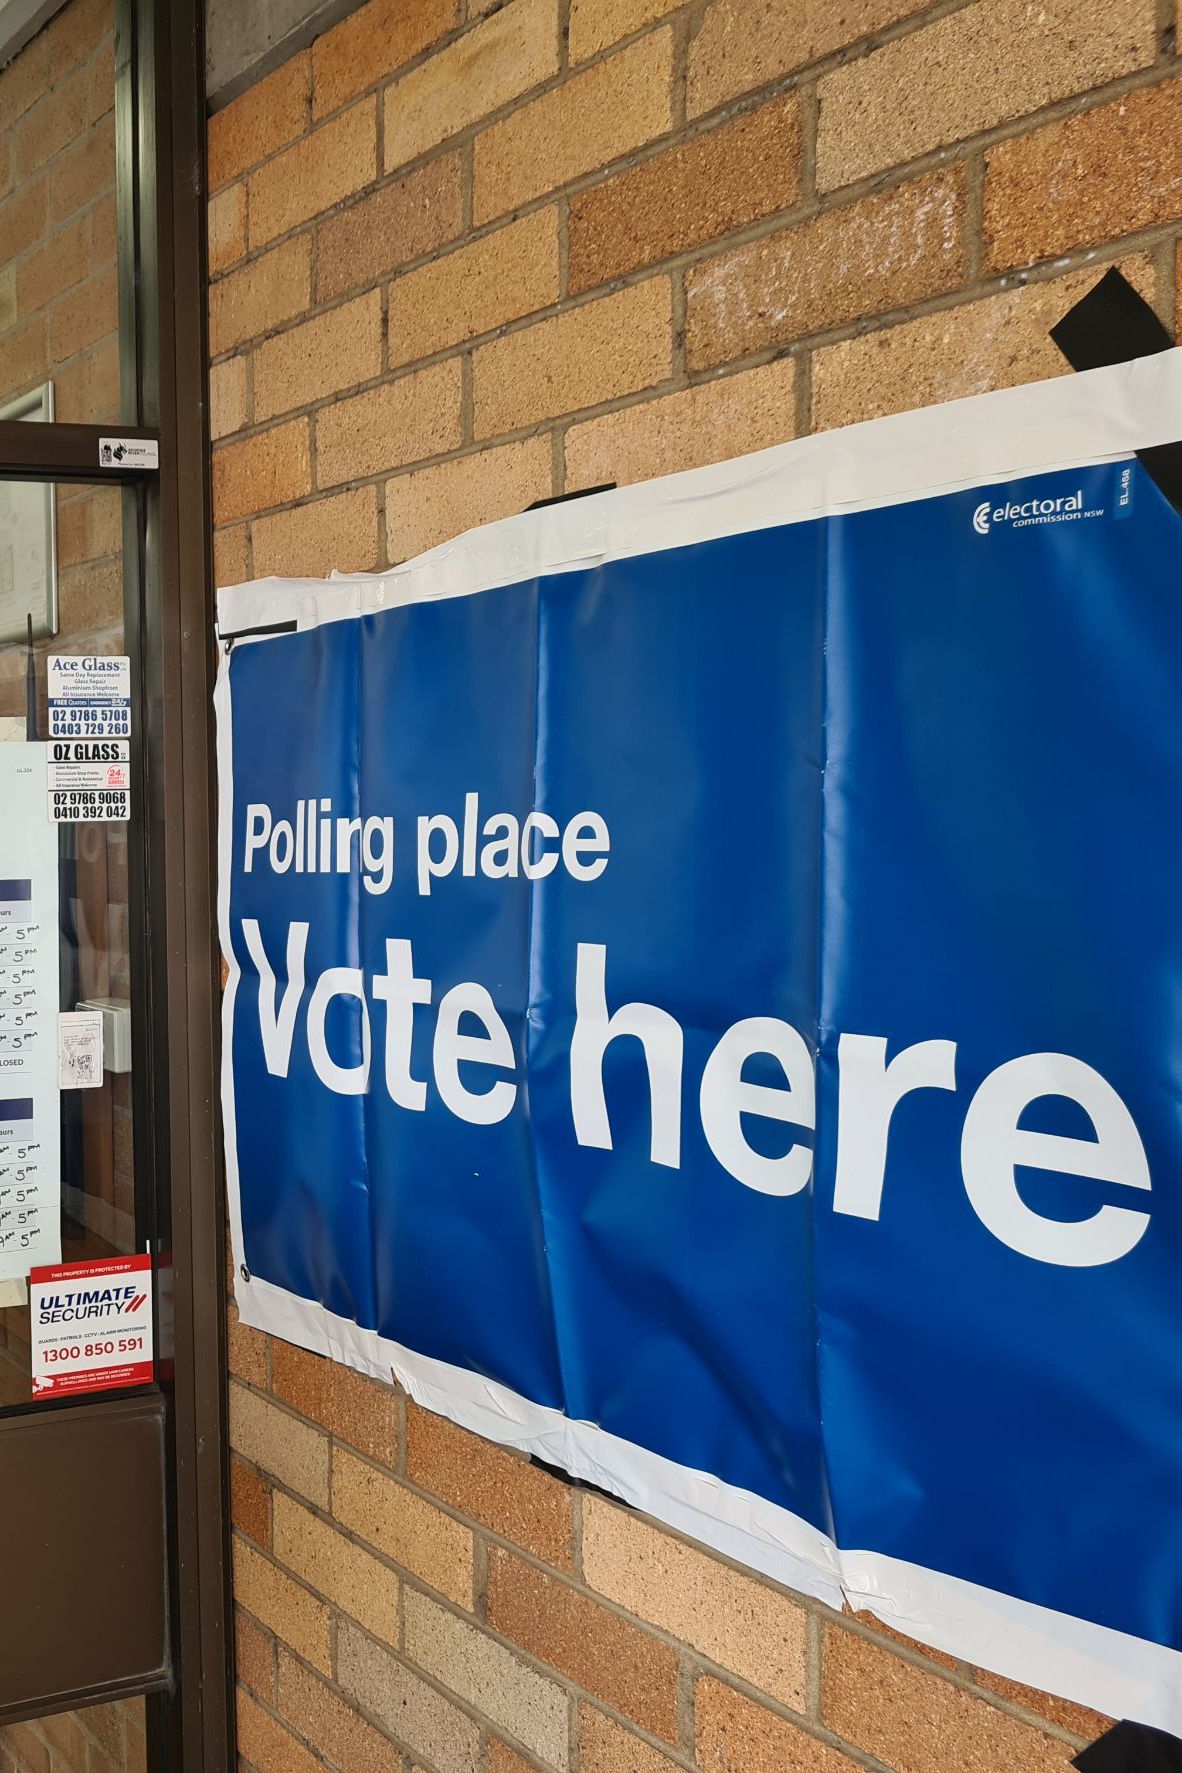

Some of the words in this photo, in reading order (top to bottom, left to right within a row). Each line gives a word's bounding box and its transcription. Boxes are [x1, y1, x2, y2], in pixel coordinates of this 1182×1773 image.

[1119, 469, 1130, 507] EL.458
[992, 490, 1082, 522] electoral
[1012, 512, 1081, 528] commission
[1083, 509, 1104, 518] NSW
[52, 657, 78, 671] Ace
[82, 657, 120, 671] Glass
[53, 709, 66, 721] 02
[70, 709, 98, 721] 9786
[101, 709, 128, 721] 5708
[53, 723, 81, 735] 0403
[85, 723, 104, 735] 729
[107, 723, 128, 735] 260
[54, 743, 71, 760] OZ
[74, 743, 119, 760] GLASS
[54, 793, 67, 805] 02
[70, 792, 96, 805] 9786
[98, 792, 126, 804] 9068
[54, 806, 80, 819] 0410
[82, 806, 103, 819] 392
[106, 805, 126, 818] 042
[243, 797, 394, 896] Polling
[417, 792, 611, 896] place
[242, 918, 517, 1125] Vote
[570, 943, 1153, 1267] here
[40, 1286, 136, 1310] ULTIMATE
[39, 1301, 126, 1325] SECURITY
[60, 1334, 82, 1342] PATROLS
[117, 1325, 147, 1333] MONITORING
[43, 1346, 81, 1362] 1300
[84, 1341, 114, 1357] 850
[118, 1337, 143, 1352] 591
